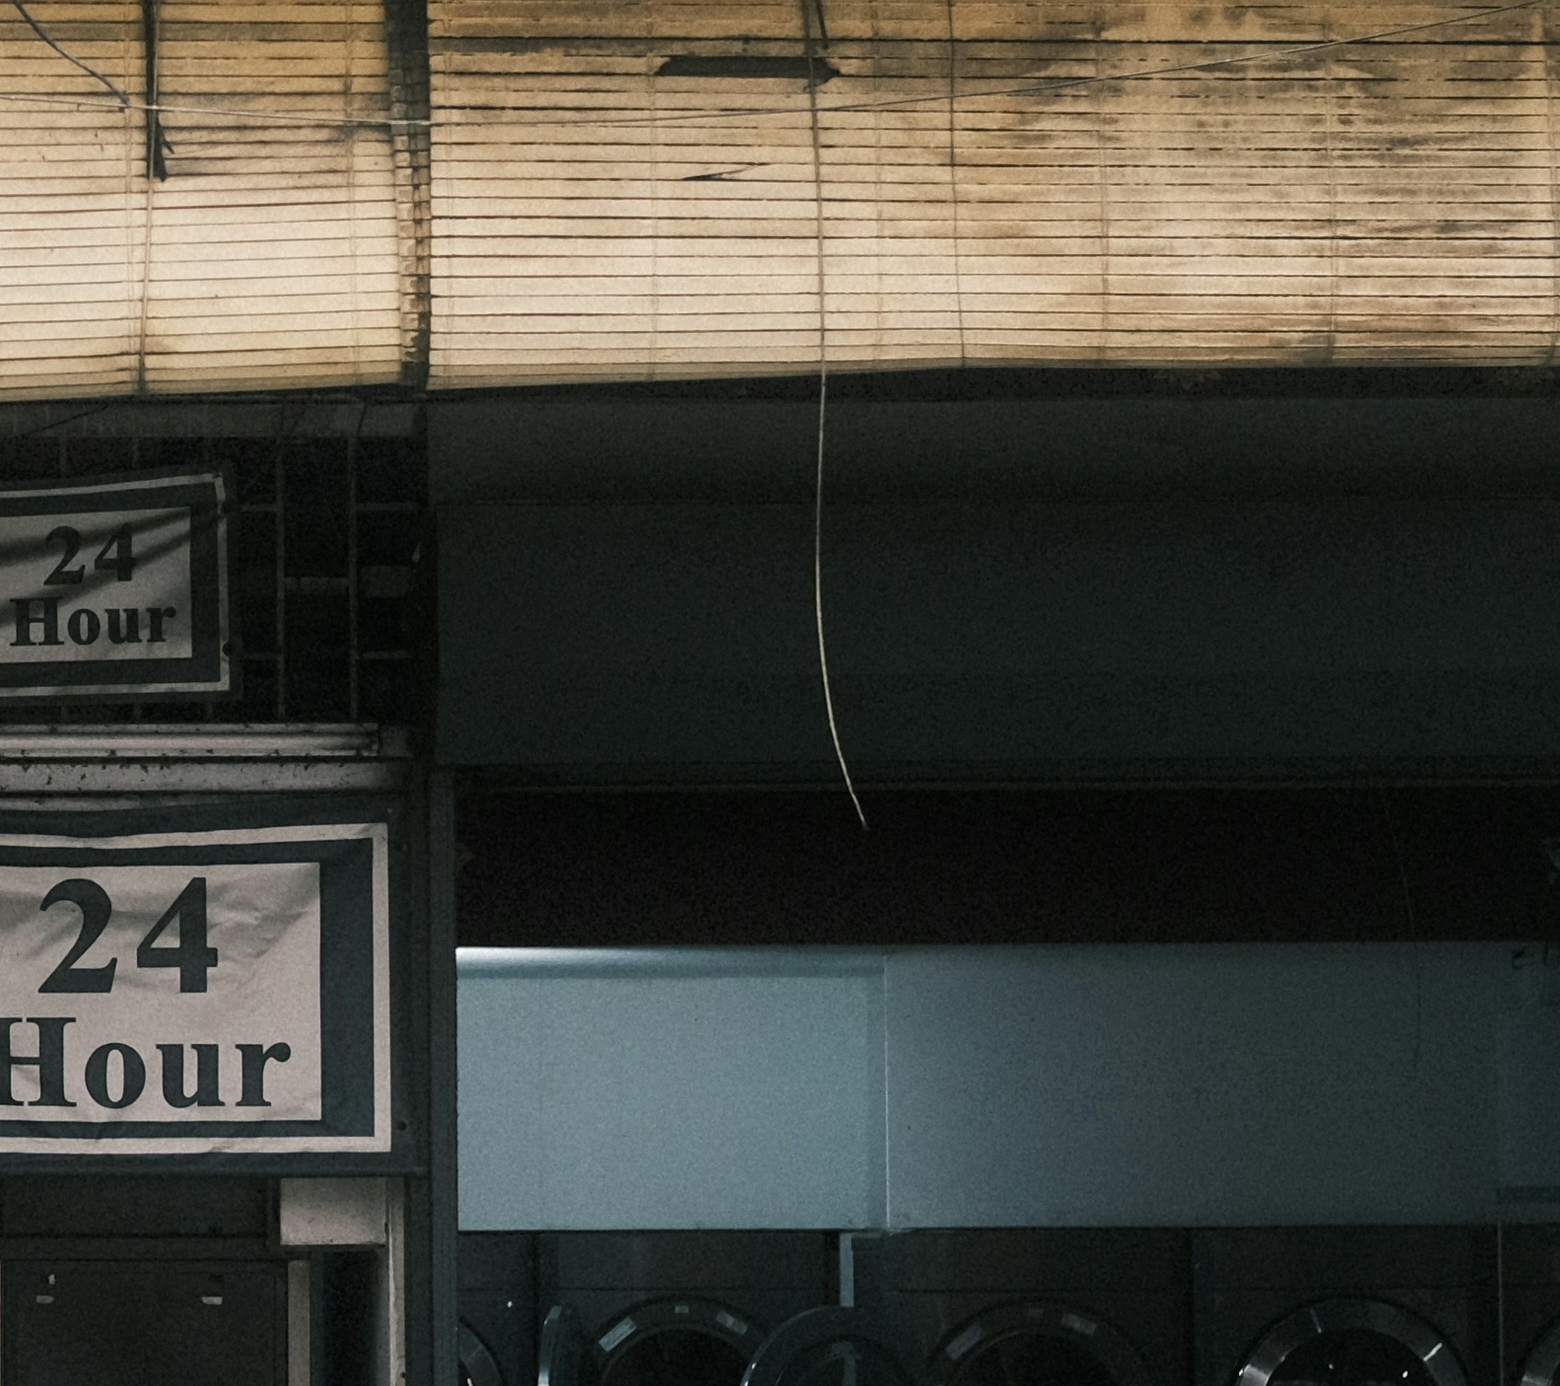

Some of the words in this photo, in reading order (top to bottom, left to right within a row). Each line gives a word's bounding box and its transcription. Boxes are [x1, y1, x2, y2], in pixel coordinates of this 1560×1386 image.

[42, 522, 138, 586] 24
[9, 593, 178, 647] Hour
[36, 877, 221, 996] 24
